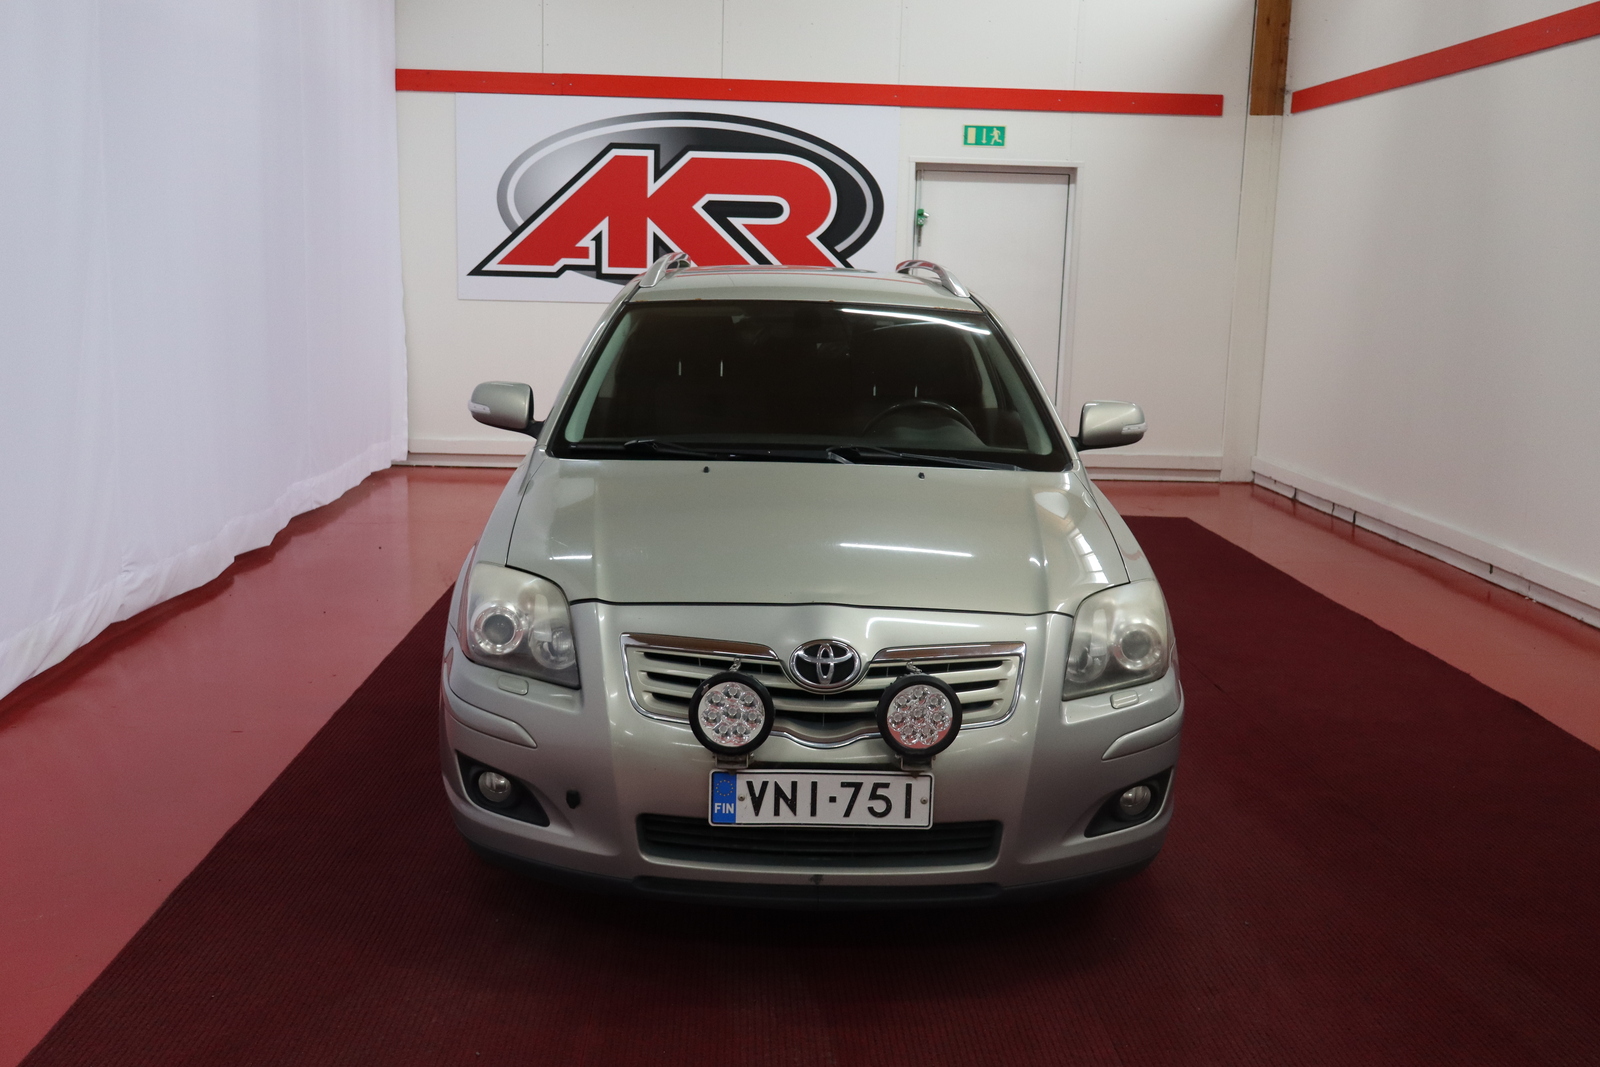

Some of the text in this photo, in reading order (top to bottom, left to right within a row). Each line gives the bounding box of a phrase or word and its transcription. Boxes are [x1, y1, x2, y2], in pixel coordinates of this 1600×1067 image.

[470, 144, 852, 277] AKR
[714, 803, 735, 814] FIN
[746, 780, 912, 819] VNI-751
